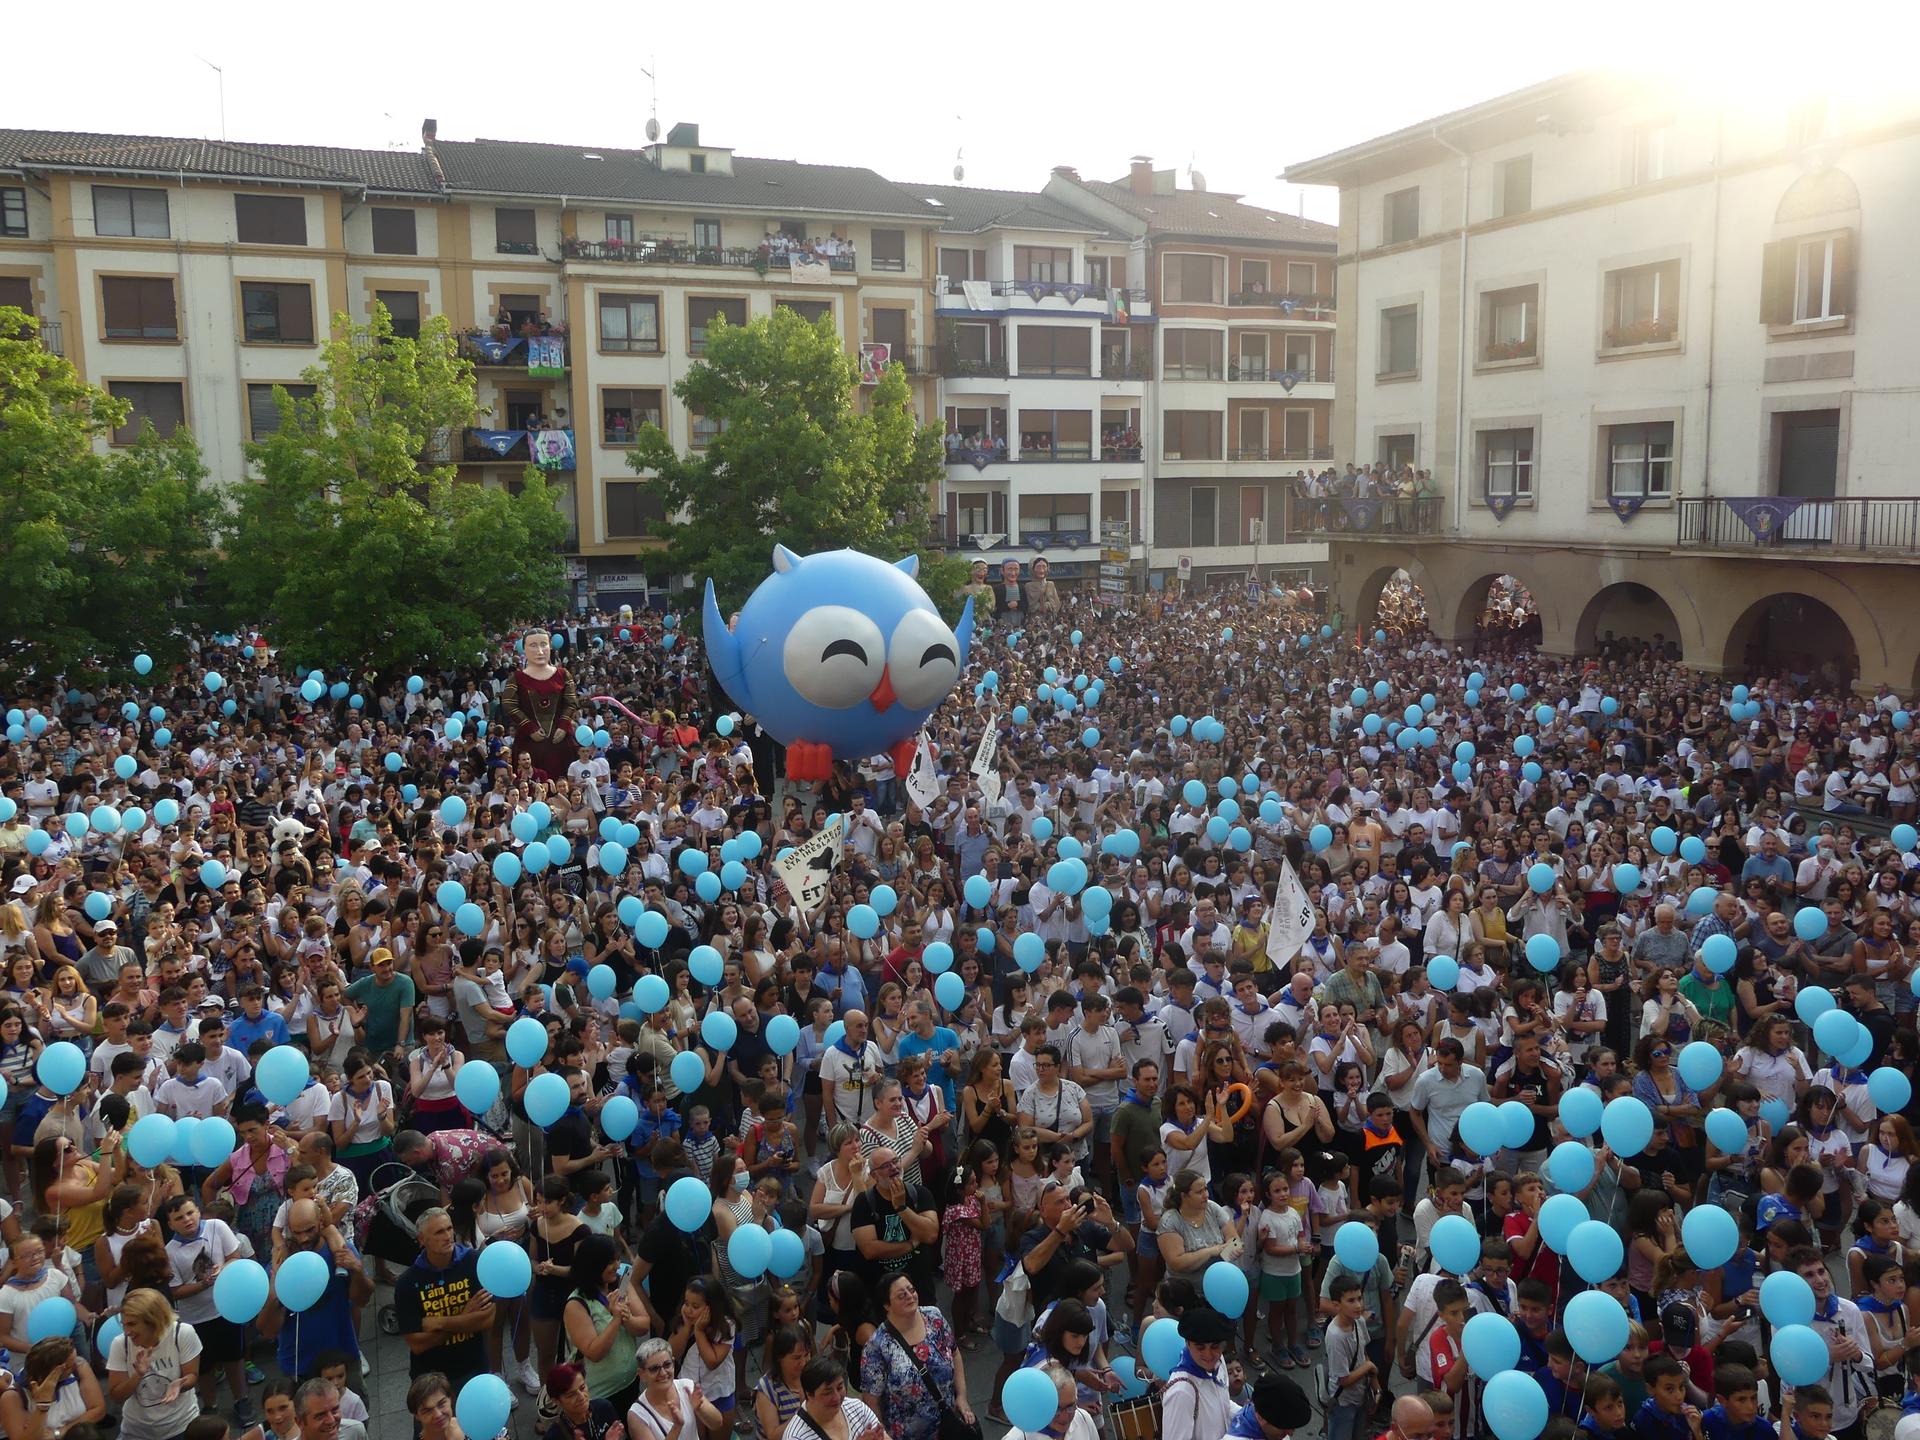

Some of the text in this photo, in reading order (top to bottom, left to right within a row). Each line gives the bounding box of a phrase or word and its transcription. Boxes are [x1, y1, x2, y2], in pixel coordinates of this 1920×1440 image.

[784, 840, 816, 865] EUSKAL
[786, 856, 801, 871] ETA
[428, 1286, 444, 1298] am
[448, 1278, 470, 1292] not
[423, 1290, 470, 1310] Perfect
